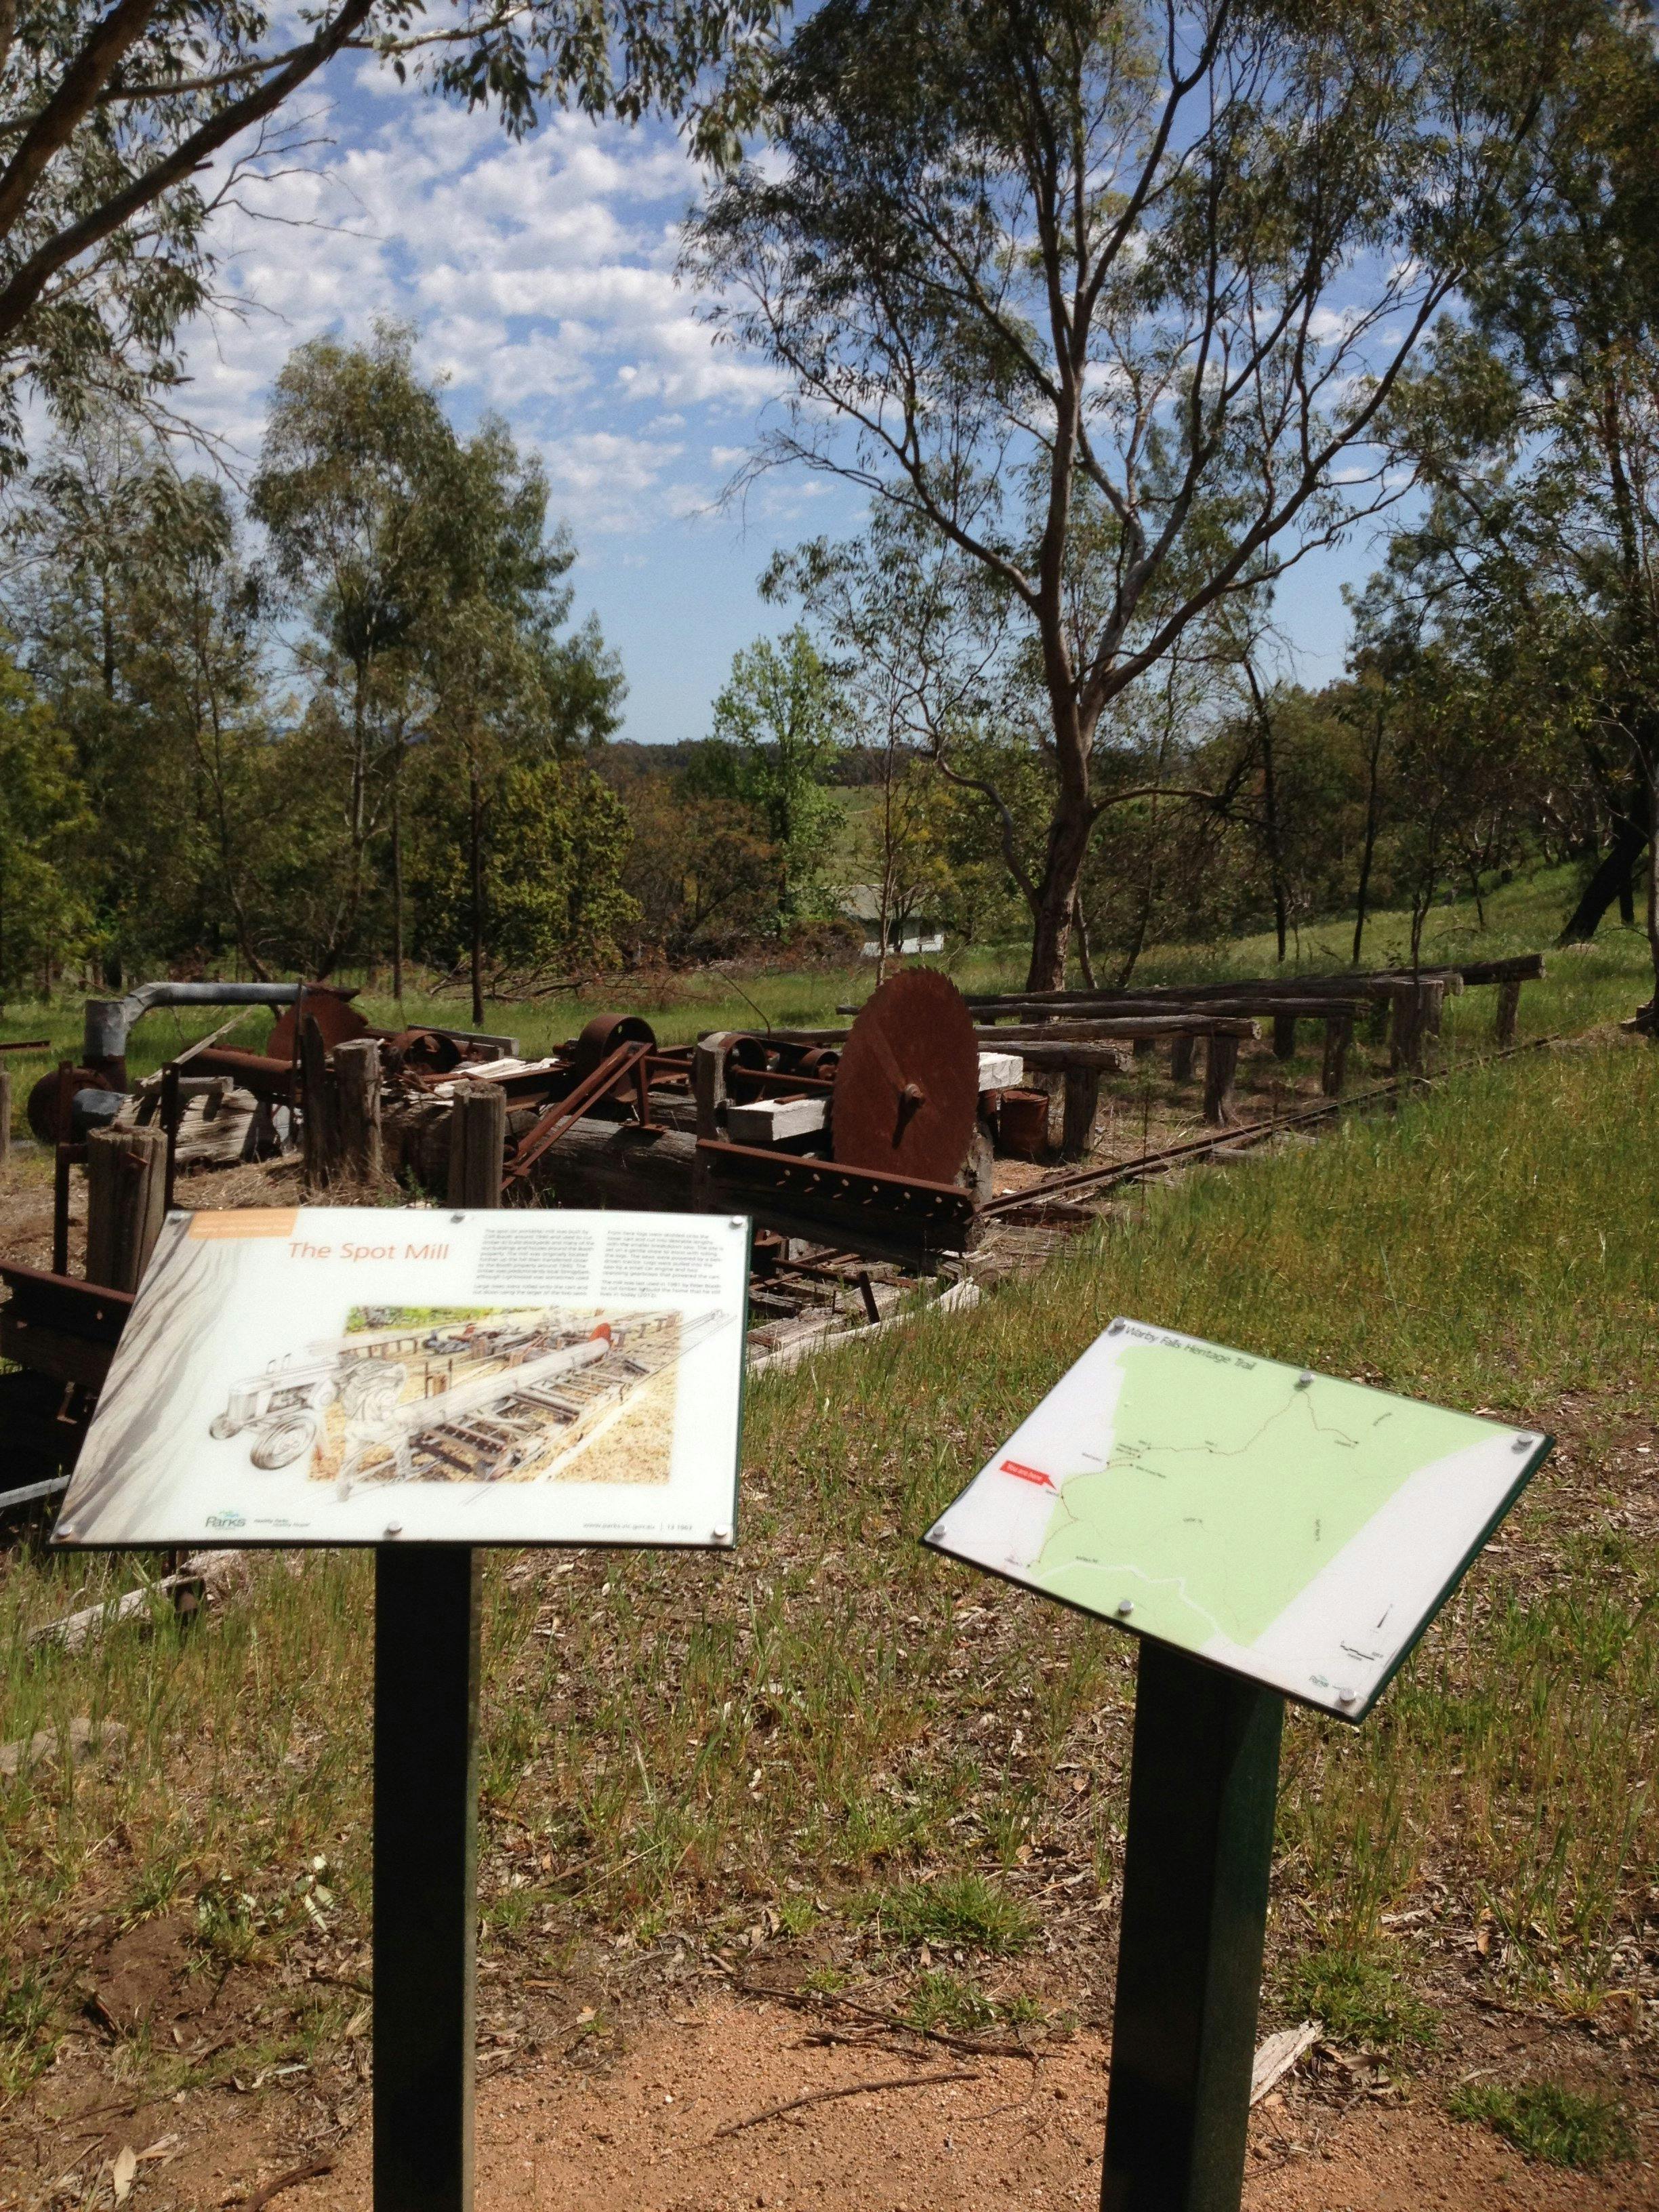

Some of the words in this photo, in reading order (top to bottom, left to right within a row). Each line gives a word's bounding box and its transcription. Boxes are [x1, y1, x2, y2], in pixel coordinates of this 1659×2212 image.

[289, 1242, 331, 1258] The
[340, 1242, 396, 1263] Spot
[405, 1244, 449, 1259] Mill
[1125, 1326, 1158, 1343] Warby
[1160, 1336, 1182, 1349] Falls
[1184, 1344, 1231, 1364] Heritage
[1235, 1357, 1257, 1370] Trail
[205, 1516, 246, 1528] Parks
